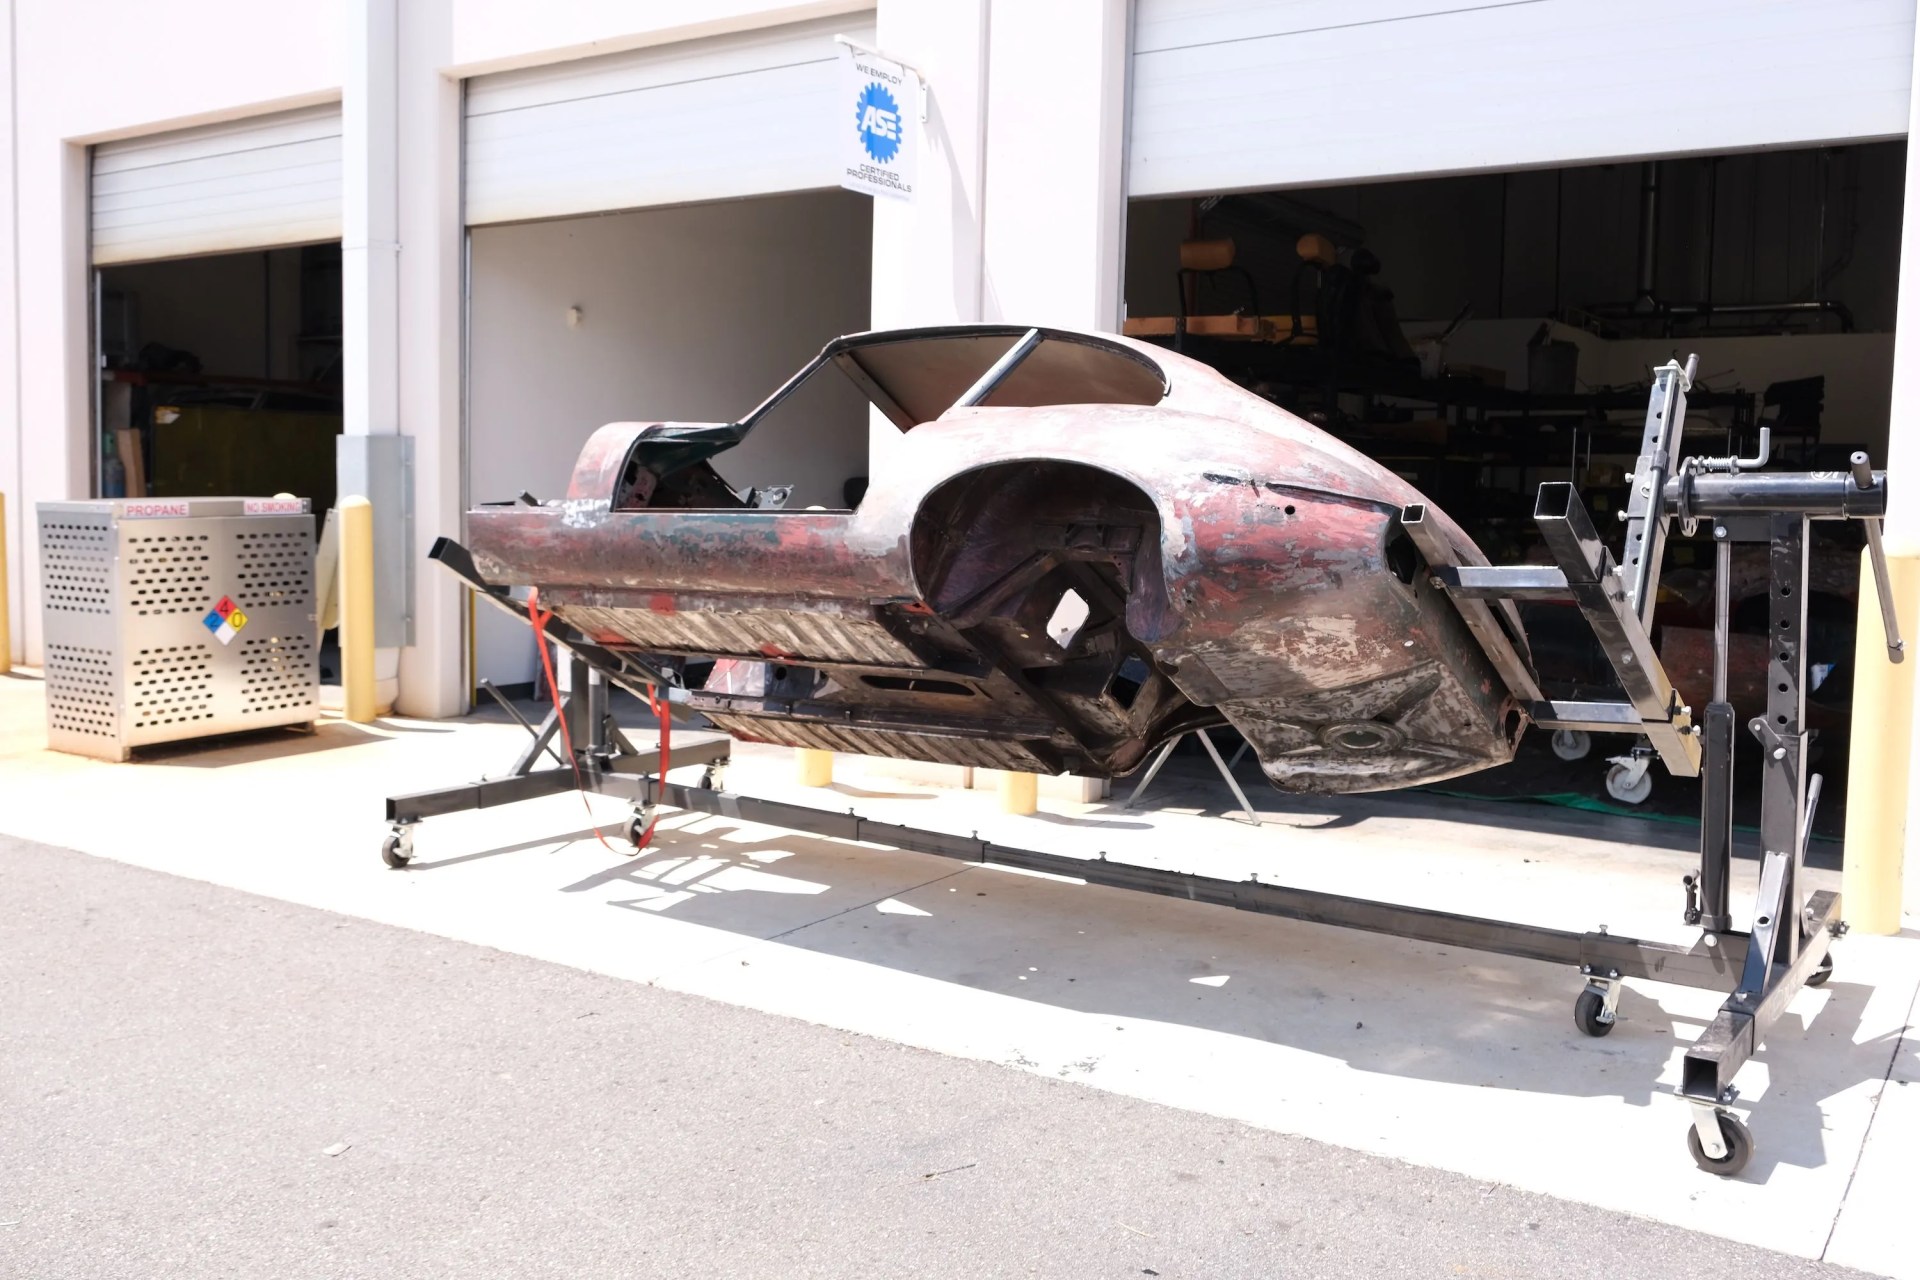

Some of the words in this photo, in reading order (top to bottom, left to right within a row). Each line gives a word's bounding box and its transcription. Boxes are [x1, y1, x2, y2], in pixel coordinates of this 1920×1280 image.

[856, 62, 869, 75] WE
[870, 68, 902, 85] EMPLOY
[861, 105, 897, 141] ASE
[846, 168, 912, 192] PROFESSIONALS
[860, 164, 899, 181] CERTIFIED
[127, 505, 186, 515] PROPANE
[247, 503, 260, 512] NO
[262, 501, 300, 512] SMOKING
[220, 601, 228, 614] 4
[210, 613, 219, 628] 2
[233, 612, 242, 628] 0
